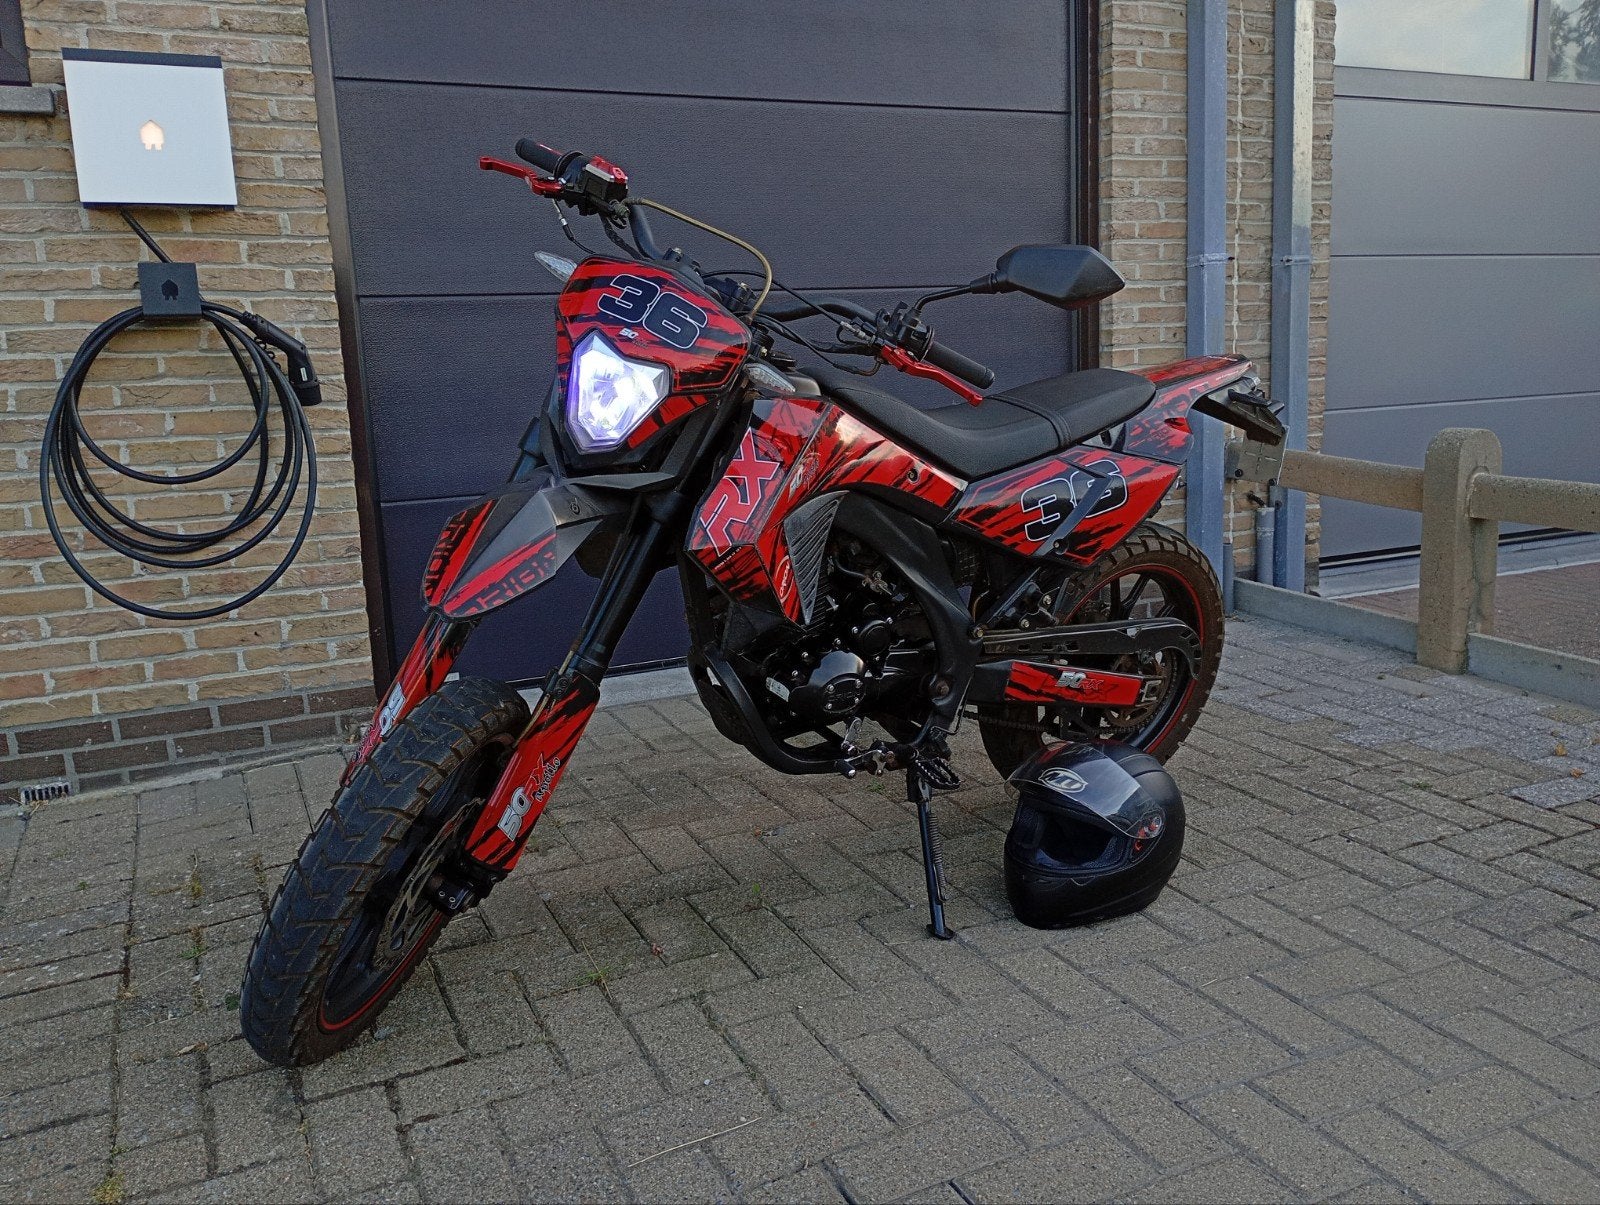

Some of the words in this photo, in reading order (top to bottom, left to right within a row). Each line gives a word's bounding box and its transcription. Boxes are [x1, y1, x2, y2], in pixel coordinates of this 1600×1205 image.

[597, 274, 707, 349] 36
[700, 427, 780, 557] RX
[1020, 459, 1128, 542] 36
[497, 786, 532, 842] 50
[533, 756, 561, 803] Apollo
